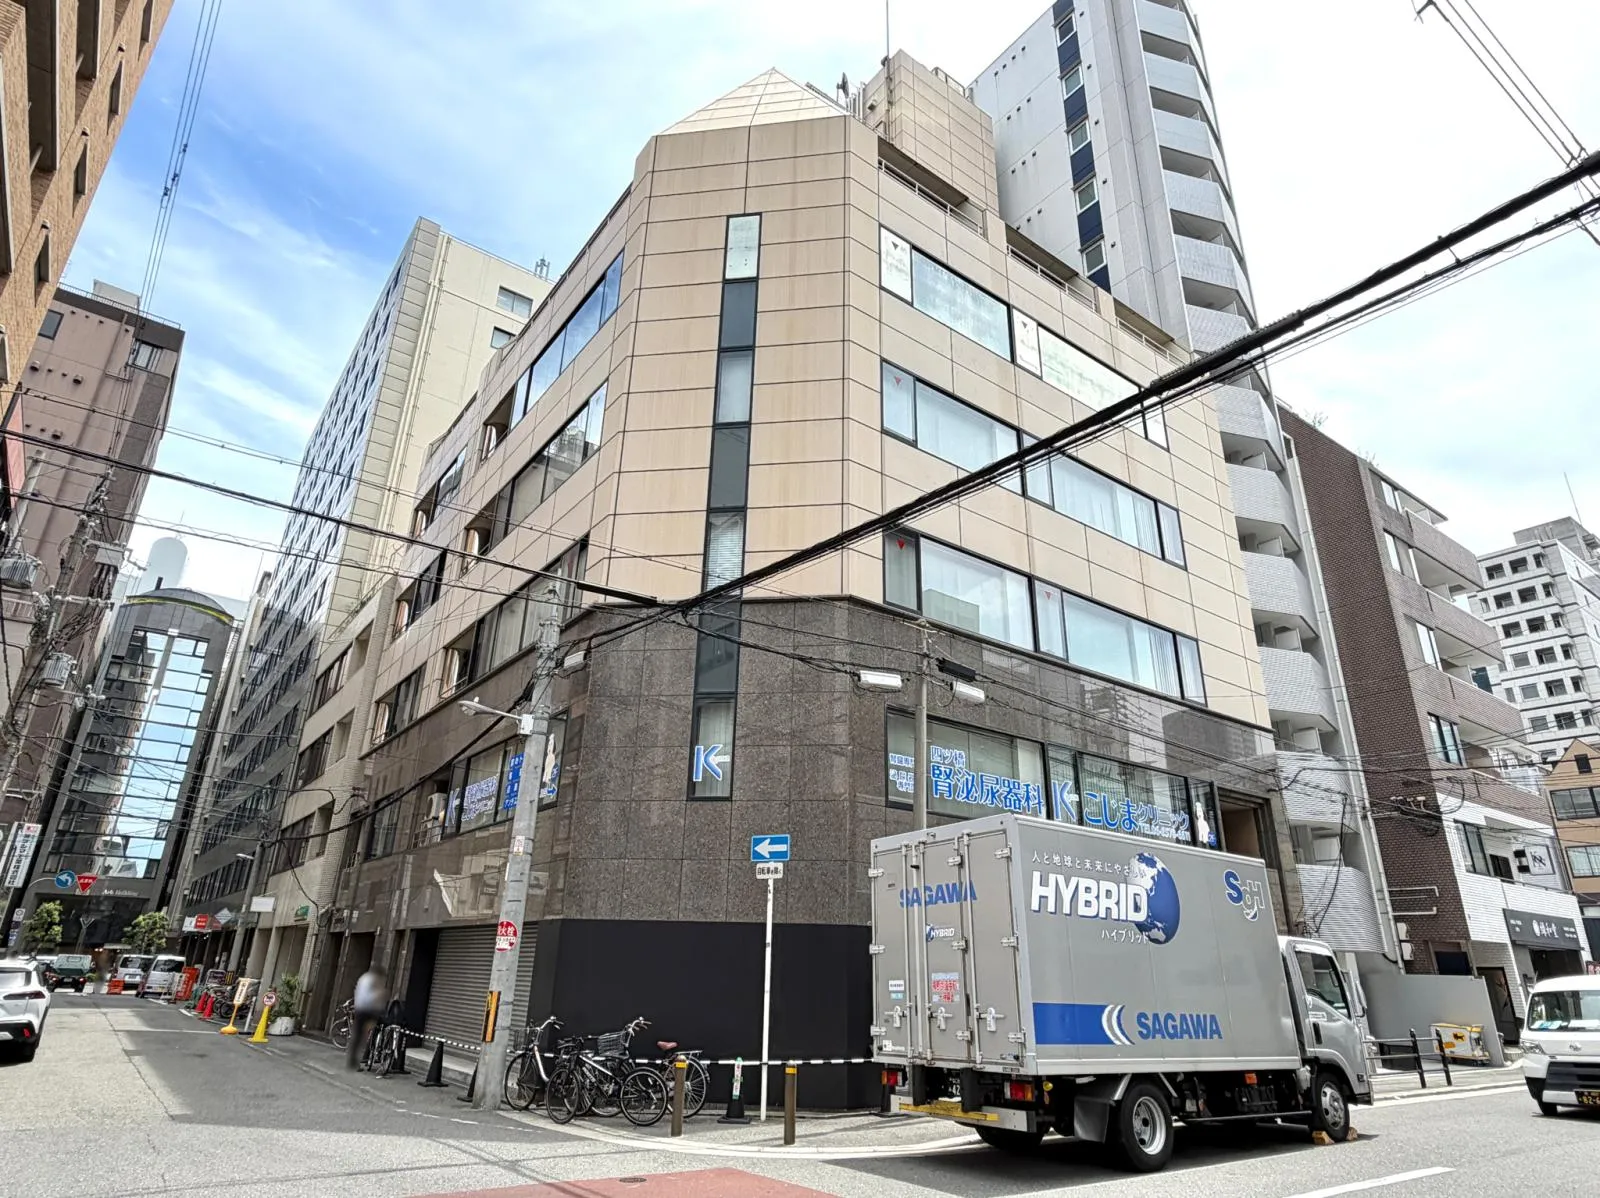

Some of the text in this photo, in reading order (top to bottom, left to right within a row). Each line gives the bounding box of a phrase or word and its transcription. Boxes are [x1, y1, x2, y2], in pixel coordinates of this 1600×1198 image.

[931, 746, 965, 768] 四ツ橋
[931, 763, 1044, 815] 腎泌尿器科
[1084, 791, 1190, 832] こじまクリニック
[1032, 850, 1147, 879] 人と地球と未来にやさしい
[899, 879, 978, 909] SAGAWA
[1031, 870, 1149, 924] HYBRID
[930, 927, 955, 938] HYBRID
[1101, 928, 1150, 944] ハイブリッド
[1136, 1011, 1223, 1040] SAGAWA
